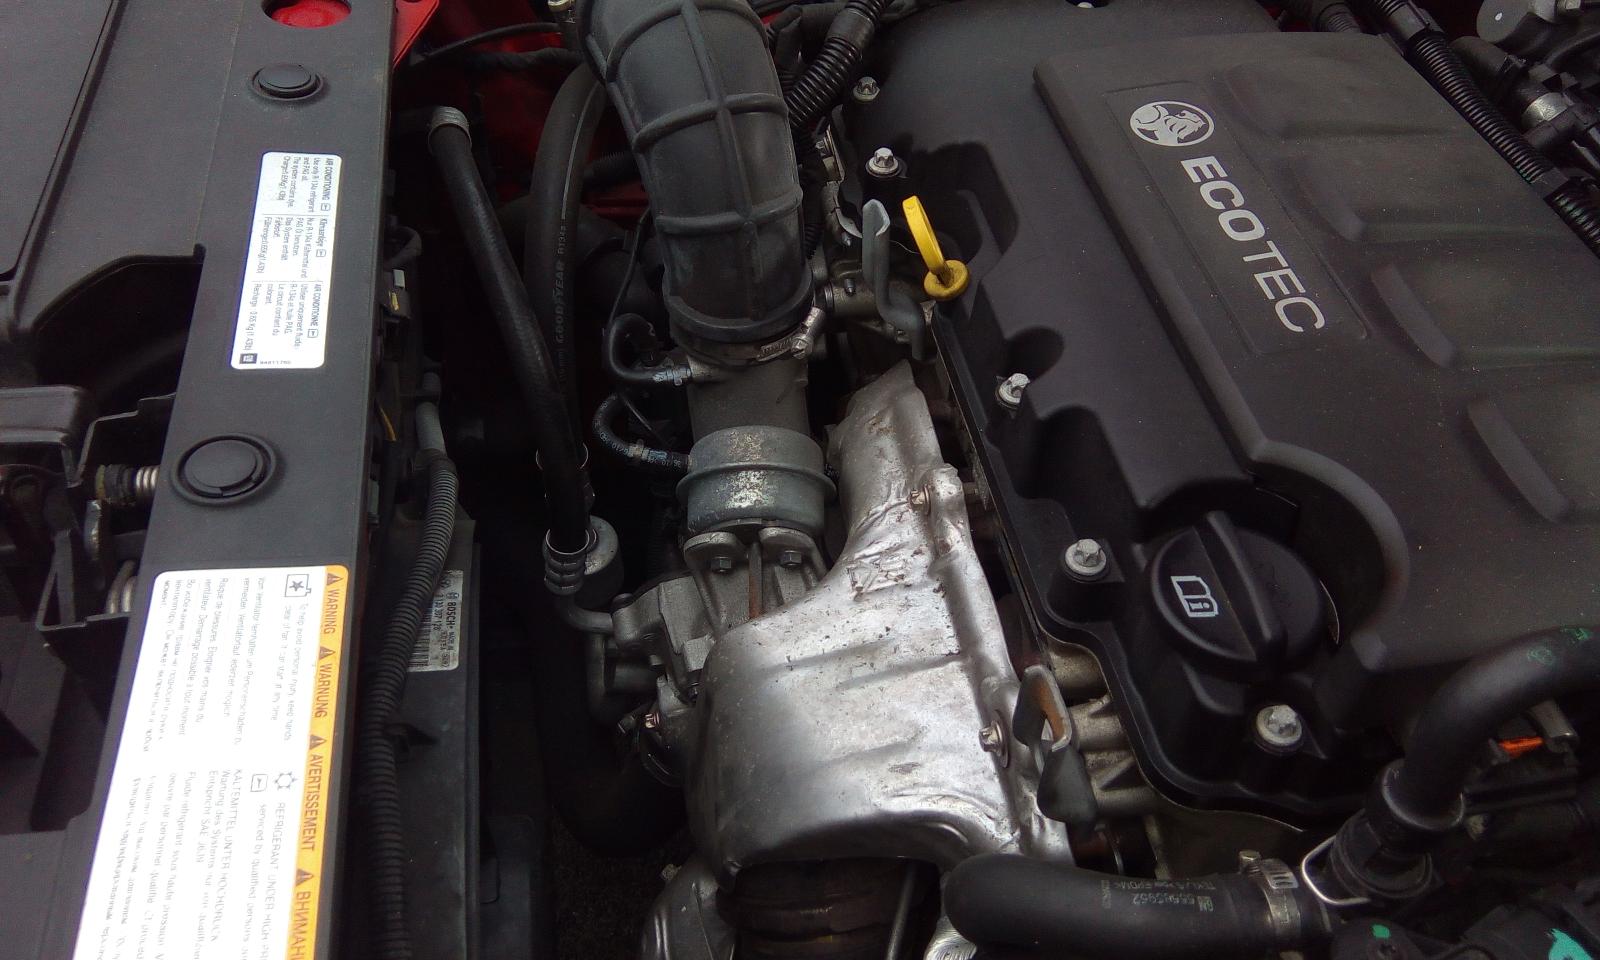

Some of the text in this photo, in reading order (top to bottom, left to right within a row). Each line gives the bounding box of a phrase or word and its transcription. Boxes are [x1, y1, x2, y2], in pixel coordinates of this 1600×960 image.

[290, 164, 298, 179] system
[293, 156, 301, 164] The
[321, 166, 332, 200] CONDITIONING
[285, 217, 293, 225] Das
[295, 217, 304, 227] PAG
[306, 217, 314, 225] Nur
[315, 218, 327, 246] Klimaanlage
[282, 227, 292, 243] System
[1180, 156, 1325, 332] ECOTEC
[249, 283, 261, 306] Recharge
[275, 290, 283, 306] circuit
[299, 283, 308, 299] Utiliser
[552, 261, 565, 344] GOODYEAR
[273, 307, 281, 327] contient
[296, 301, 304, 331] uniquement
[215, 577, 228, 599] Risque
[215, 601, 222, 609] de
[322, 588, 339, 634] WARNING
[446, 601, 456, 625] BOSCH
[187, 652, 198, 680] possible
[291, 647, 301, 675] personal
[183, 689, 192, 702] tout
[197, 690, 207, 711] mains
[314, 663, 332, 718] WARNUNG
[202, 770, 218, 814] Entspricht
[215, 769, 230, 806] Wartung
[302, 754, 323, 851] AVERTISSEMENT
[199, 818, 209, 835] SAE
[213, 809, 224, 825] des
[255, 804, 266, 840] serviced
[207, 829, 221, 868] Systems
[252, 844, 262, 854] by
[269, 802, 285, 869] REFRIGERANT
[220, 835, 232, 868] UNTER
[247, 858, 260, 898] qualified
[264, 874, 276, 909] UNDER
[210, 872, 228, 941] HOCHDRUCK
[261, 913, 271, 939] HIGH
